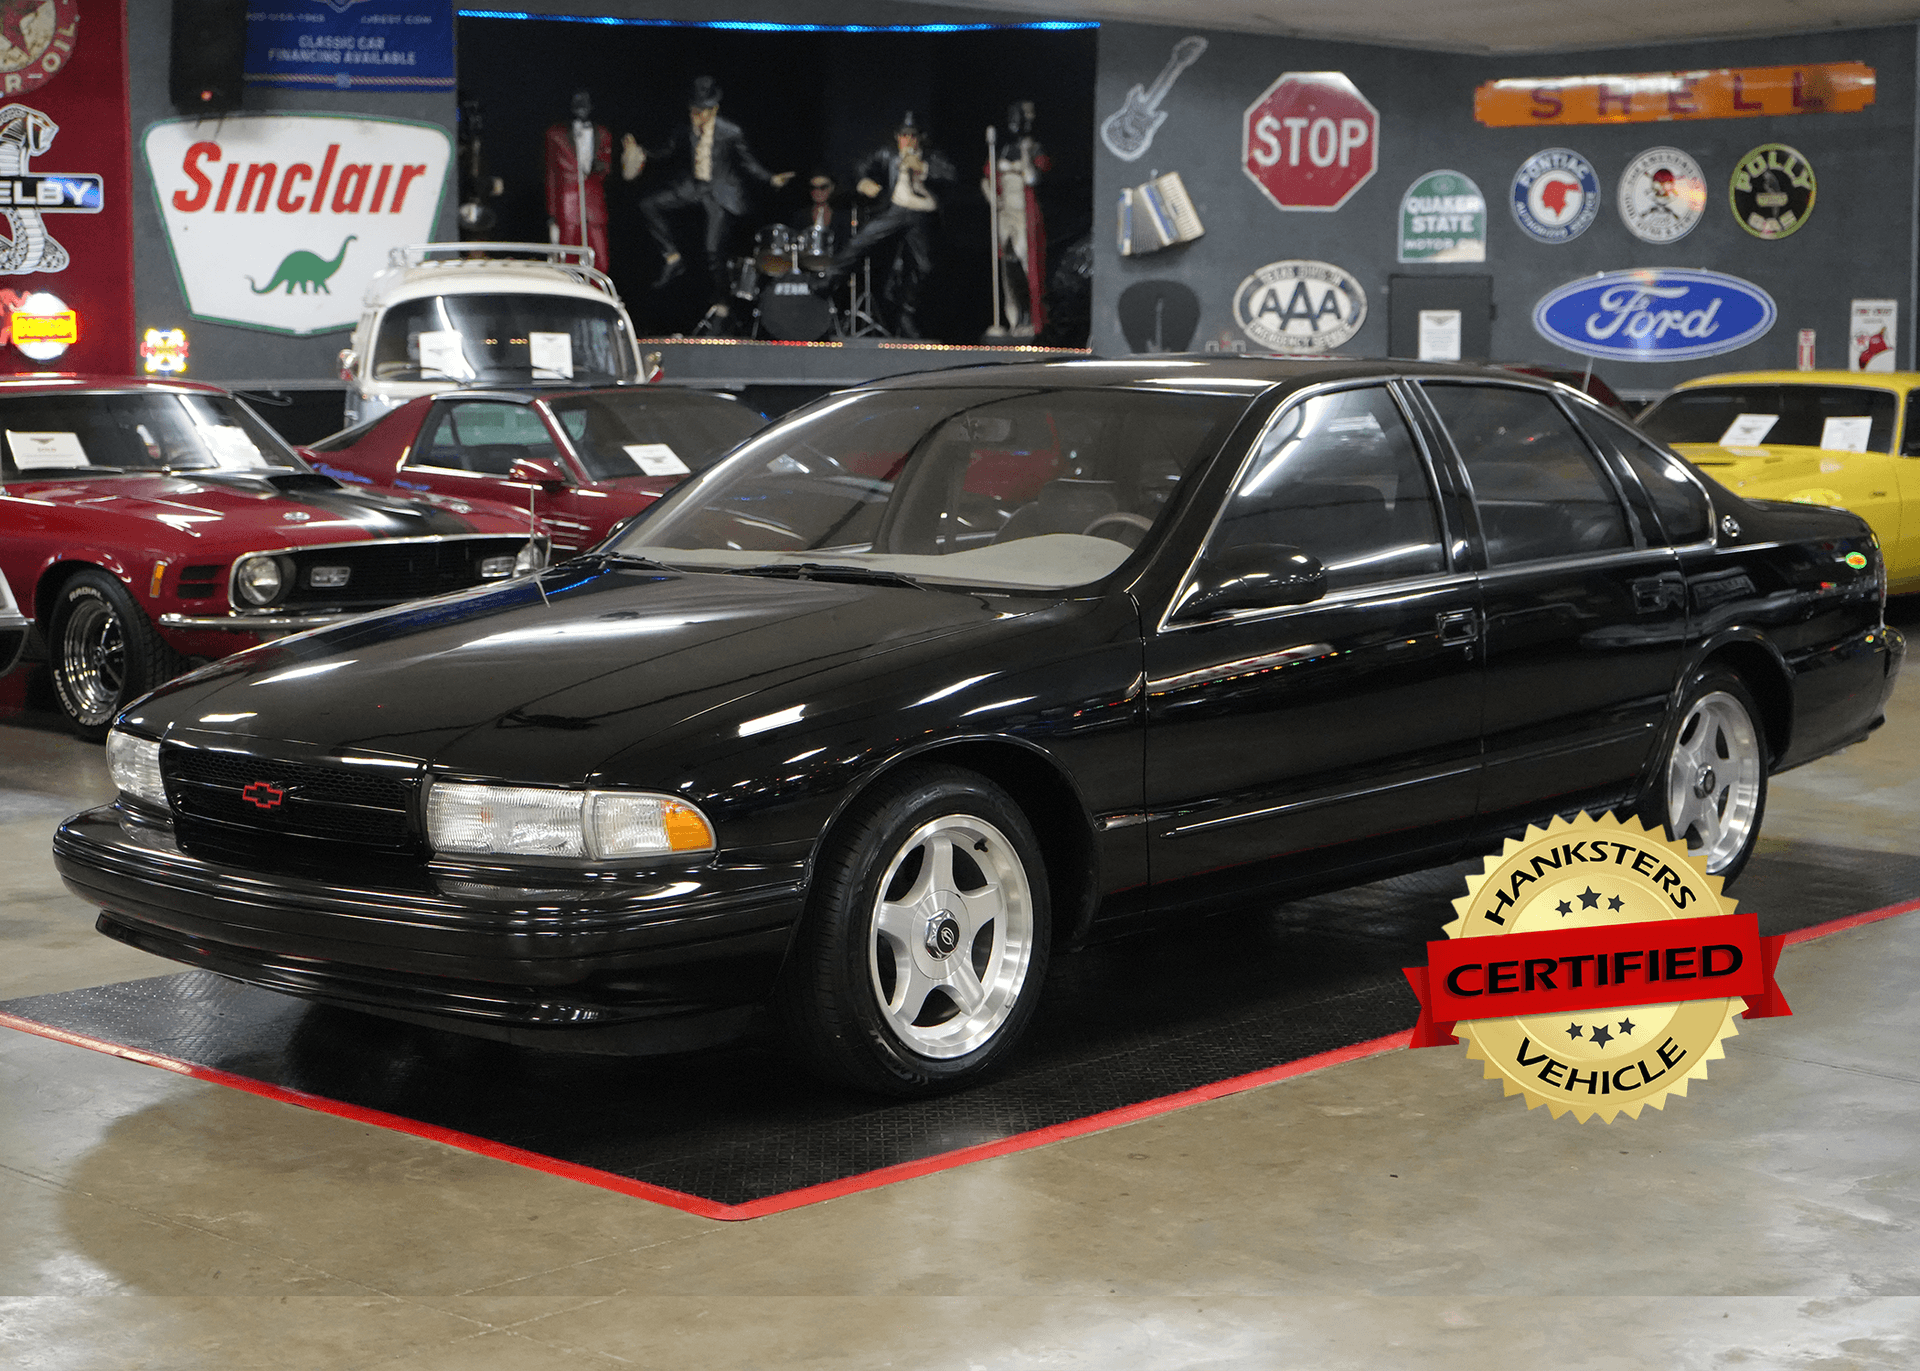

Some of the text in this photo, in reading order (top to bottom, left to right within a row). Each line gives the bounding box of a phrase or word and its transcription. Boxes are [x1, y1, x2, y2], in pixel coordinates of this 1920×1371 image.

[268, 48, 416, 65] FINANCING AVAILABLE
[298, 35, 385, 50] CLASSIC CAR
[1530, 70, 1823, 120] SHELL
[1254, 115, 1369, 168] STOP
[172, 141, 427, 214] Sinclair
[1519, 153, 1590, 187] PONTIAC
[1736, 150, 1812, 192] POLLY
[1407, 195, 1483, 214] QUAKER
[1412, 215, 1474, 233] STATE
[1258, 280, 1342, 332] AAA
[1585, 283, 1723, 340] Ford
[69, 586, 103, 601] RADIAL
